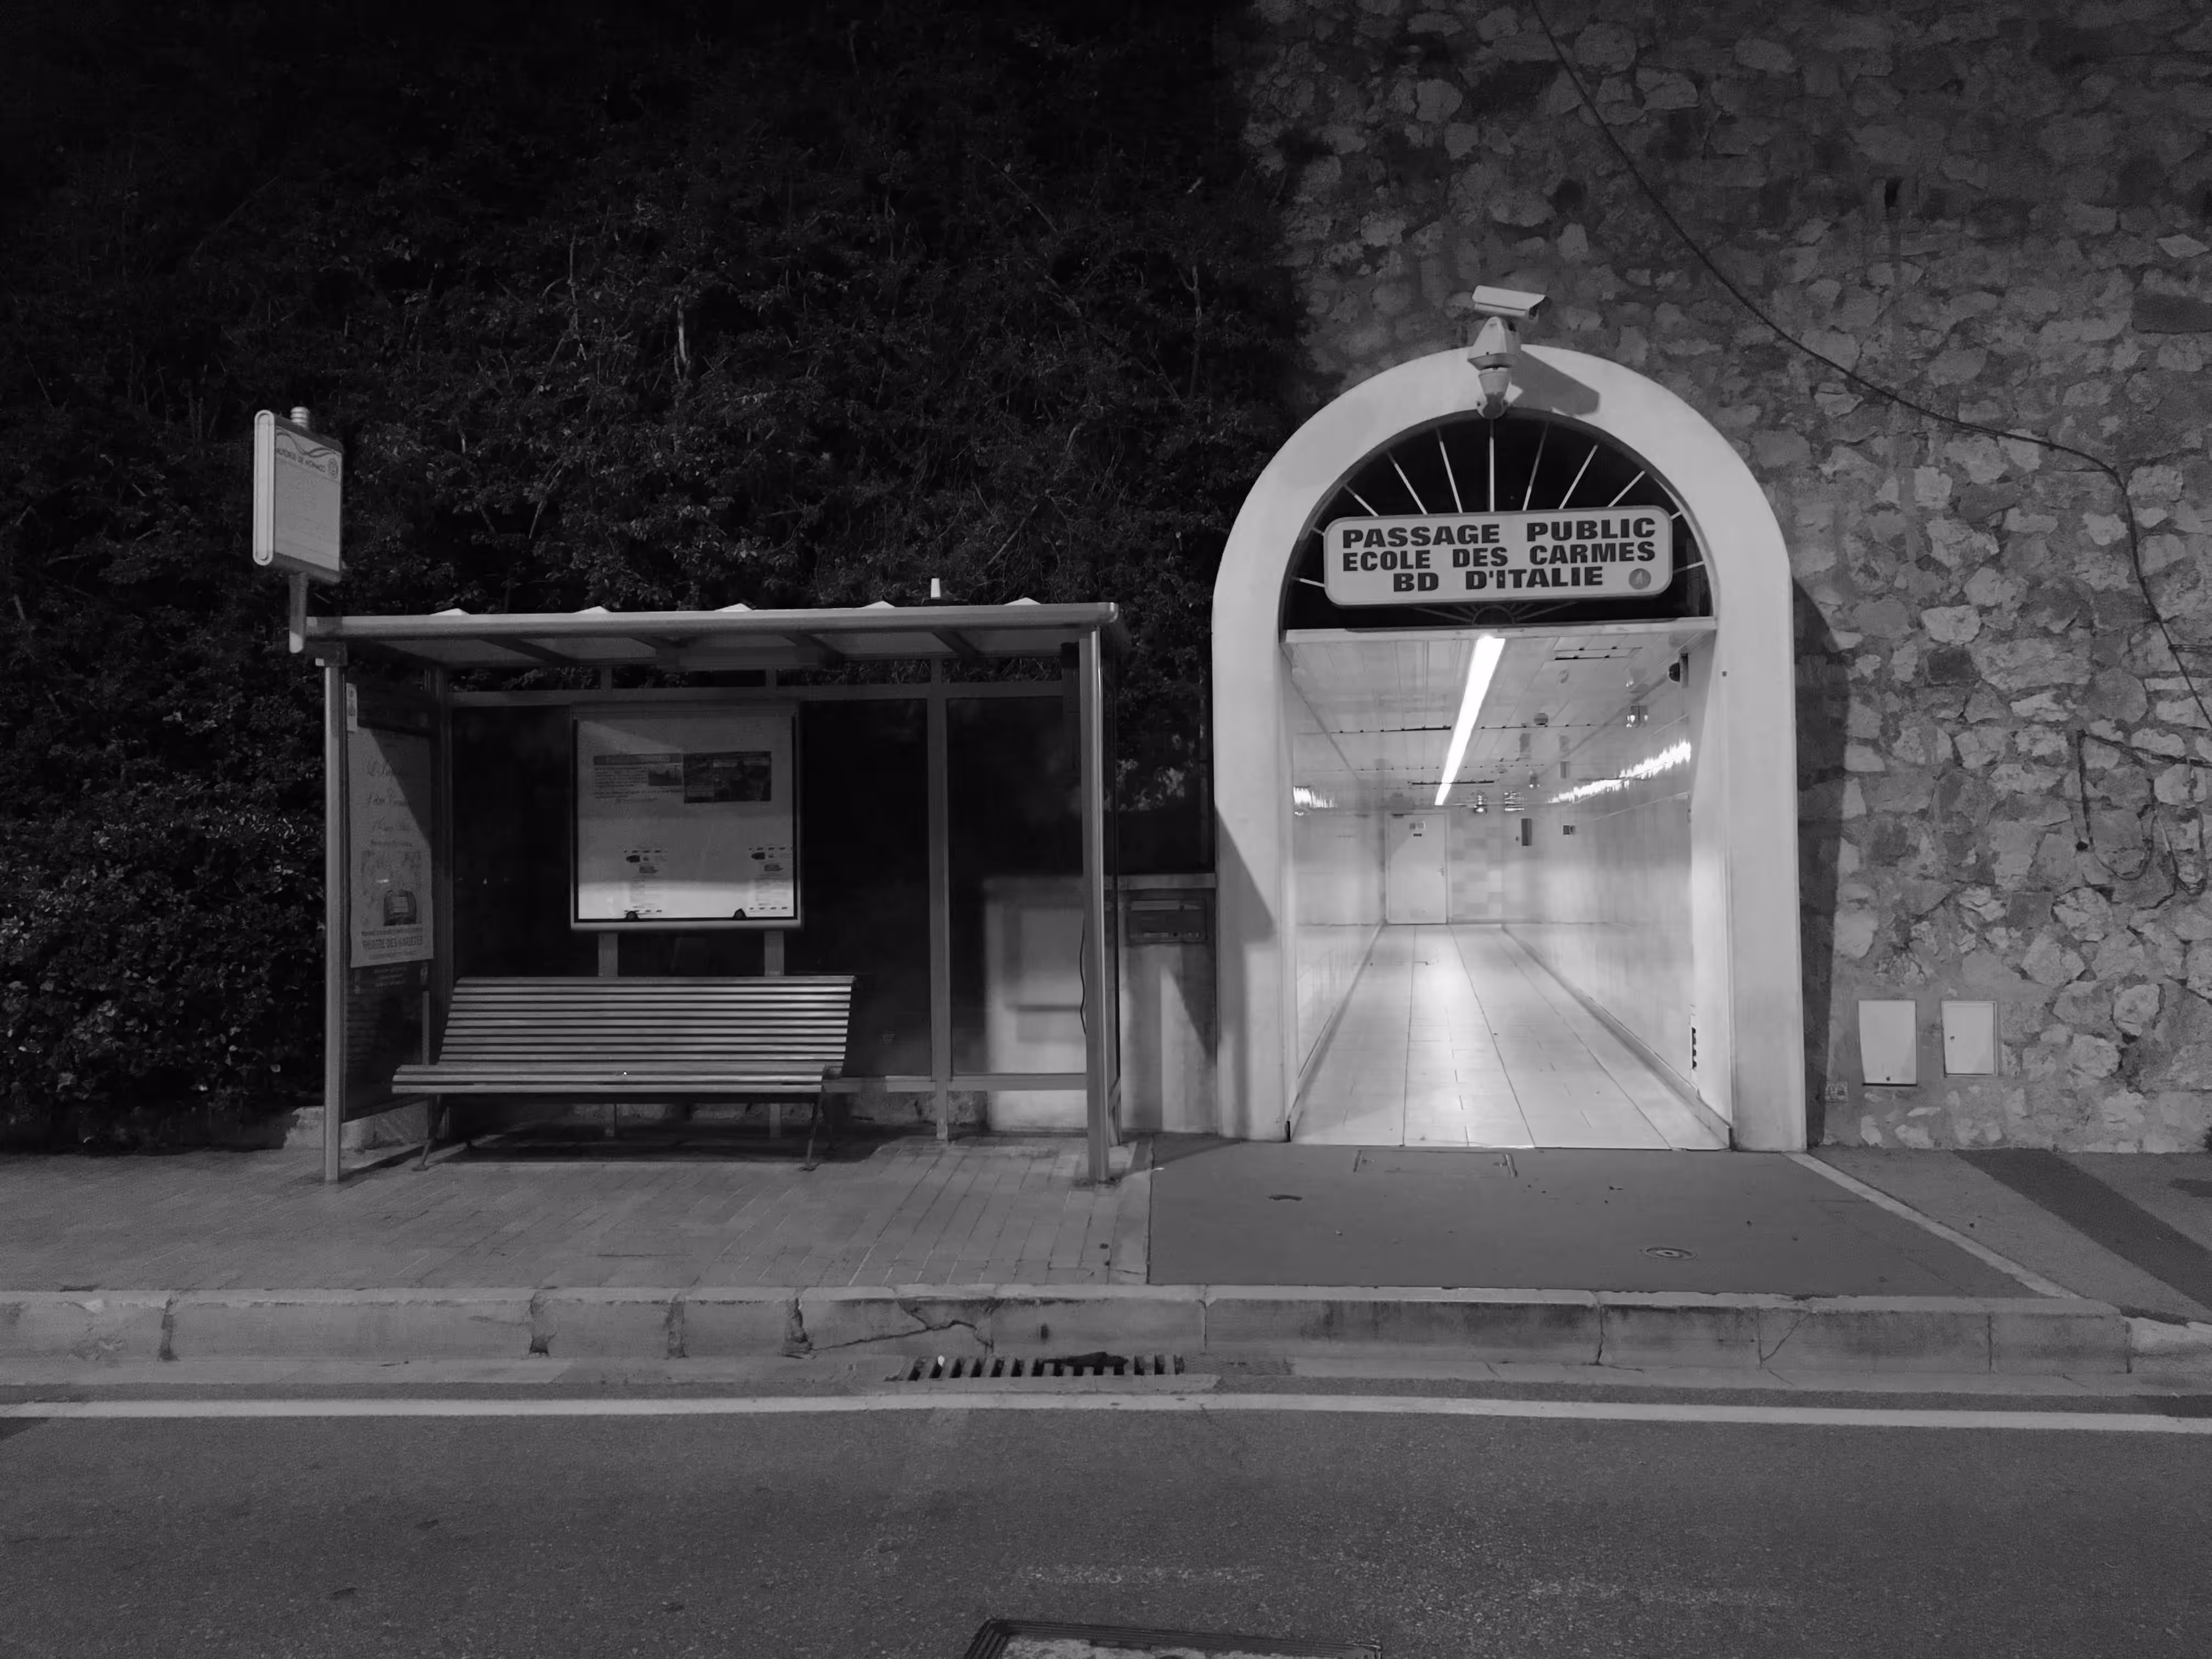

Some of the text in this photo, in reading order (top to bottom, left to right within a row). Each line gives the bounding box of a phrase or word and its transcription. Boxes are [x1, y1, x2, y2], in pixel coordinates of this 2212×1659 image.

[1342, 517, 1656, 549] PASSAGE PUBLIC
[1342, 541, 1656, 572] ECOLE DES CARMES
[1393, 566, 1603, 592] BD D'ITALIE
